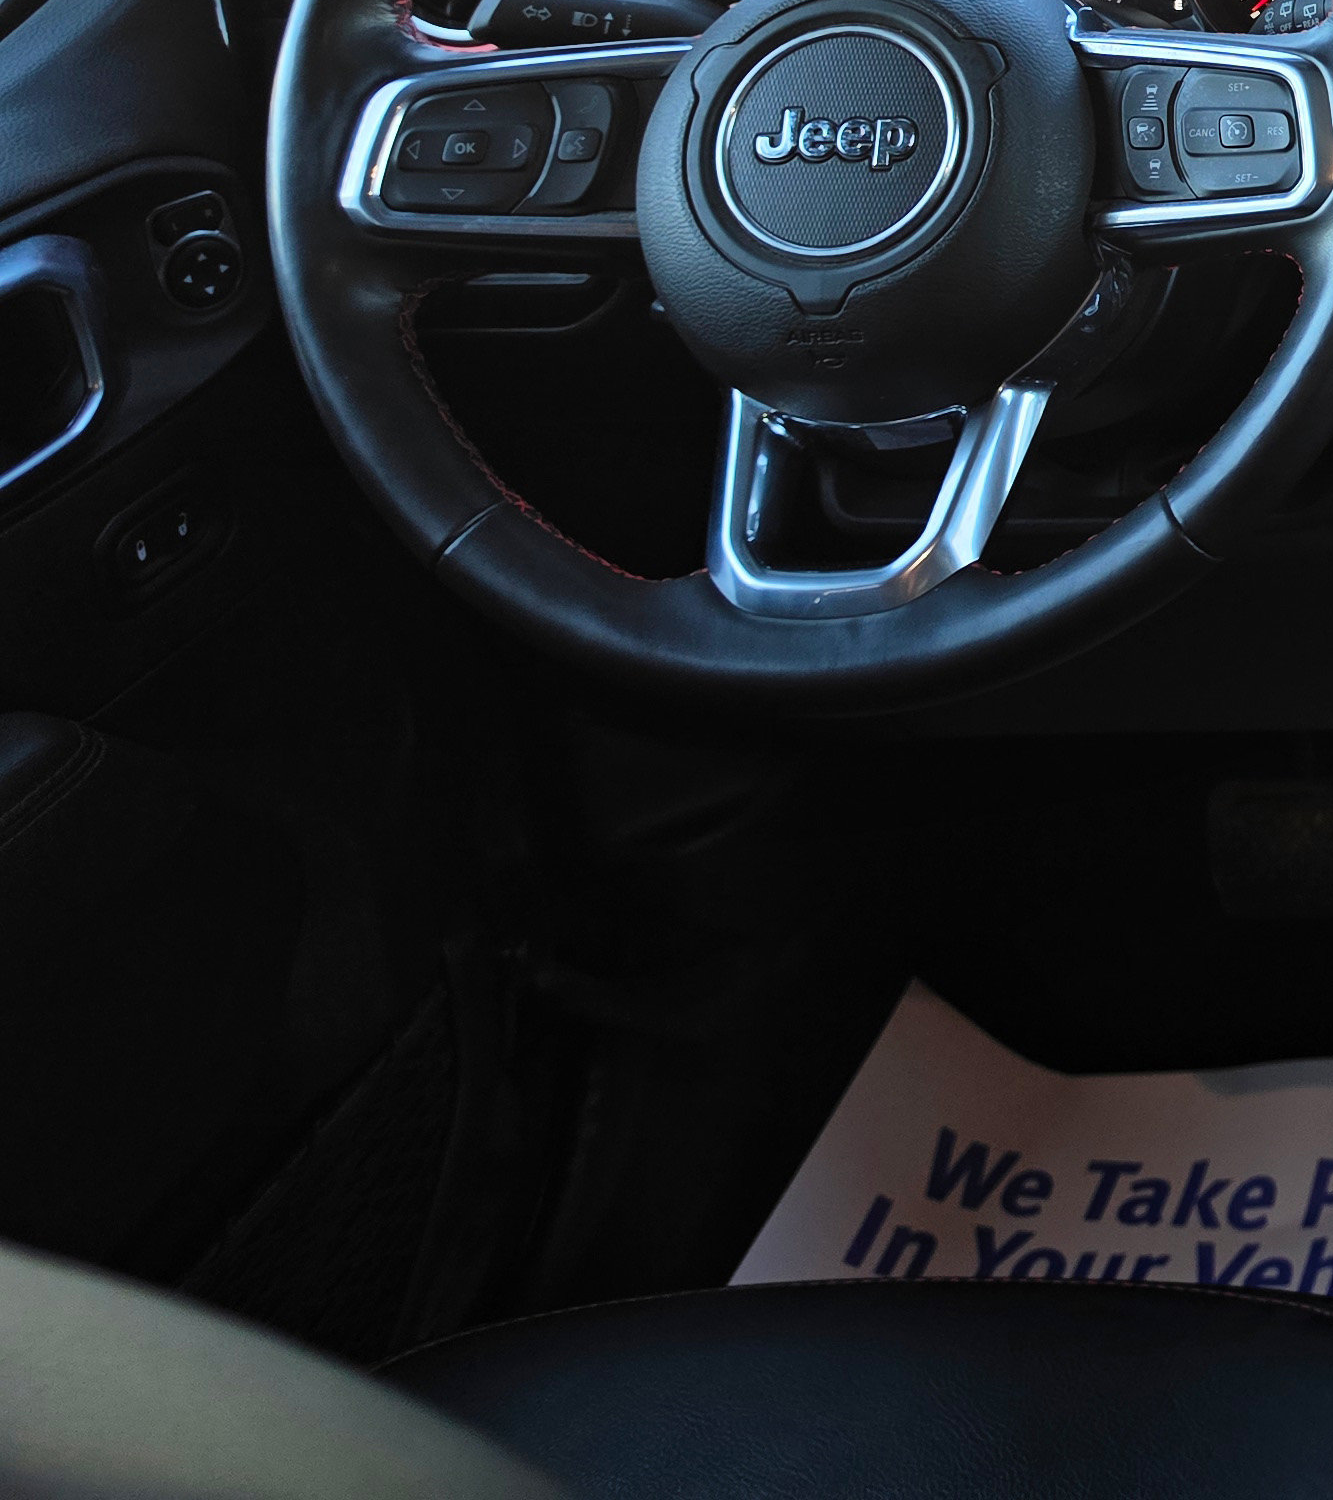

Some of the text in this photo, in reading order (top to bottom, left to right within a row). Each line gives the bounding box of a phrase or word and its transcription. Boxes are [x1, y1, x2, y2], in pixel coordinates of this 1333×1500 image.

[1173, 0, 1183, 11] E
[1280, 22, 1293, 32] OFF
[1188, 127, 1216, 138] CANC
[1267, 127, 1284, 136] RES
[755, 106, 919, 172] Jeep
[454, 142, 476, 155] OK
[925, 1126, 1055, 1217] We
[1083, 1158, 1277, 1230] Take
[843, 1195, 938, 1279] In
